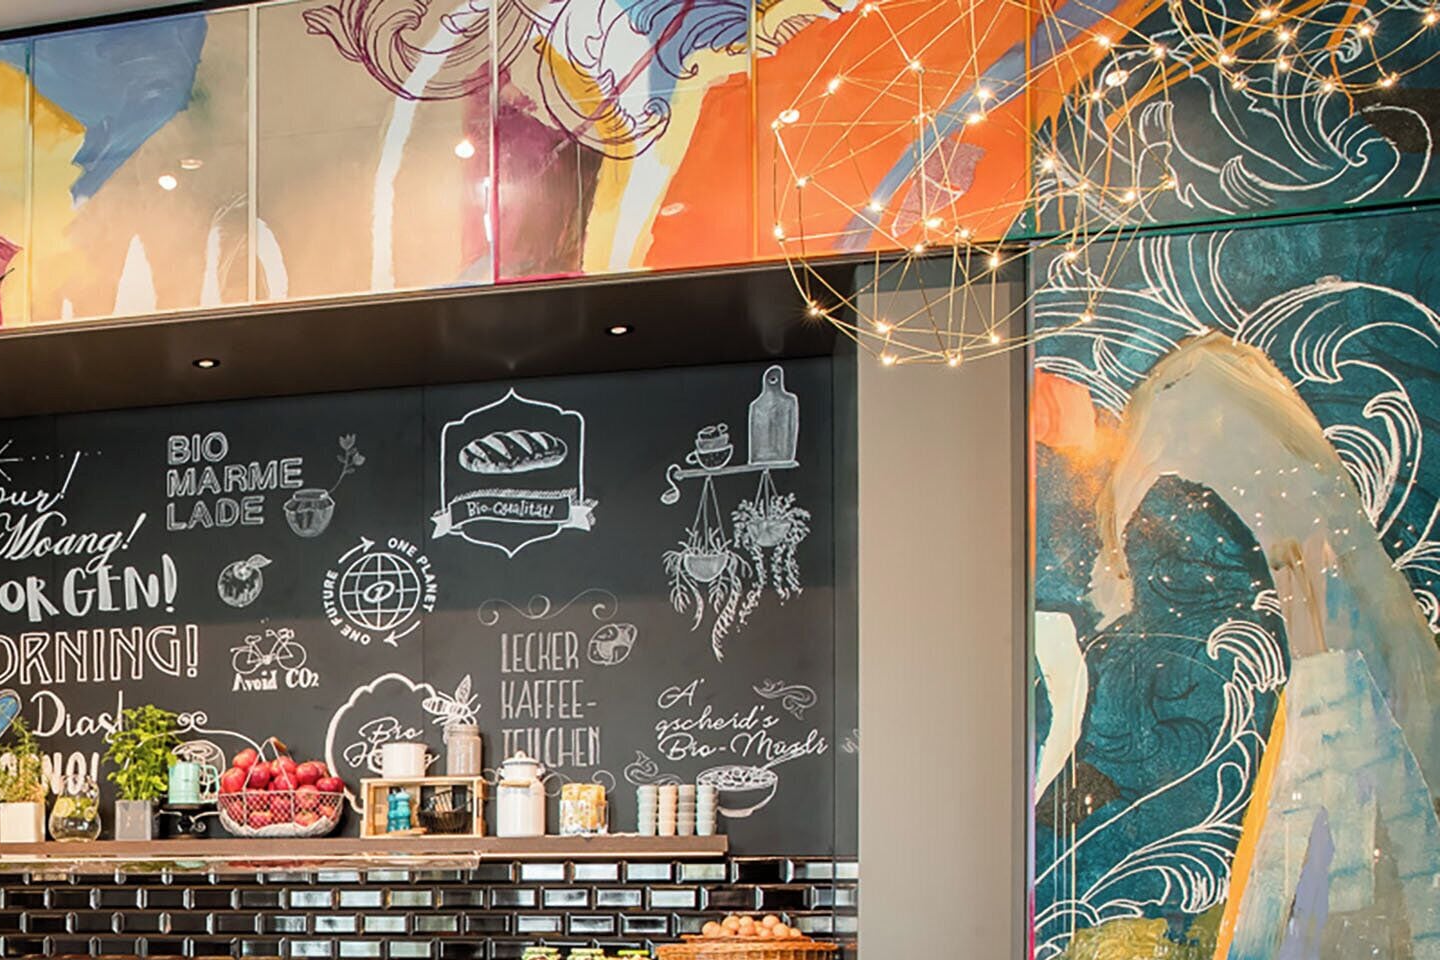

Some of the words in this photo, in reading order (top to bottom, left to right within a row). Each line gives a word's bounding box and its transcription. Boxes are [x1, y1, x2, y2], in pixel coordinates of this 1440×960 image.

[167, 431, 229, 465] BIO
[167, 457, 304, 497] MARME
[167, 495, 265, 531] LADE
[387, 537, 418, 558] ONE
[416, 555, 438, 613] PLANET
[322, 569, 344, 627] FUTURE
[339, 624, 371, 645] ONE
[501, 631, 580, 673] LECKER
[232, 669, 278, 692] Avoid
[501, 679, 597, 720] KAFFEE-
